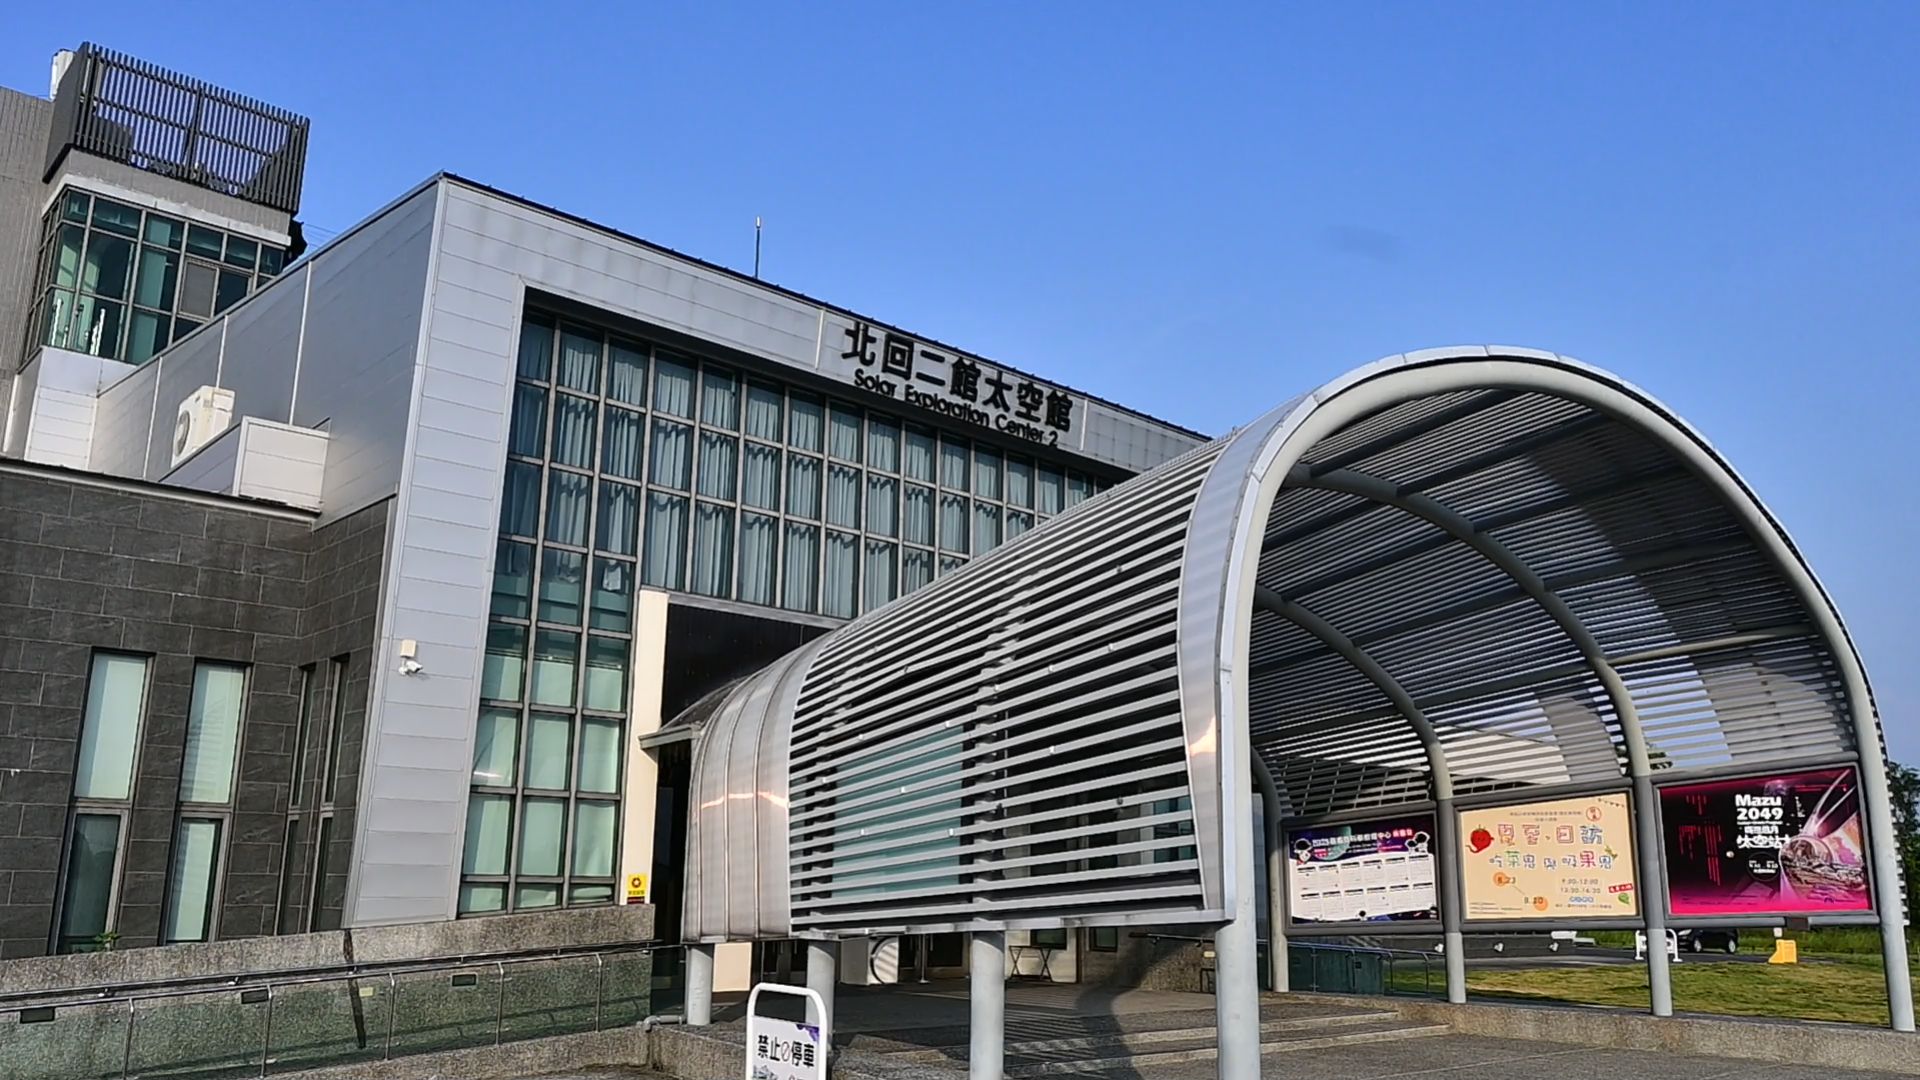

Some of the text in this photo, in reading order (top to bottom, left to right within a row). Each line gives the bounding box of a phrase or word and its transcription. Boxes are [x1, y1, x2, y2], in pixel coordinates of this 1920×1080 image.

[841, 322, 1074, 432] 北回二館太空館
[854, 368, 1059, 447] Solar Exploration Center 2
[1735, 794, 1782, 807] Mazu
[1736, 807, 1783, 821] 2049
[758, 1035, 814, 1068] 禁止停車
